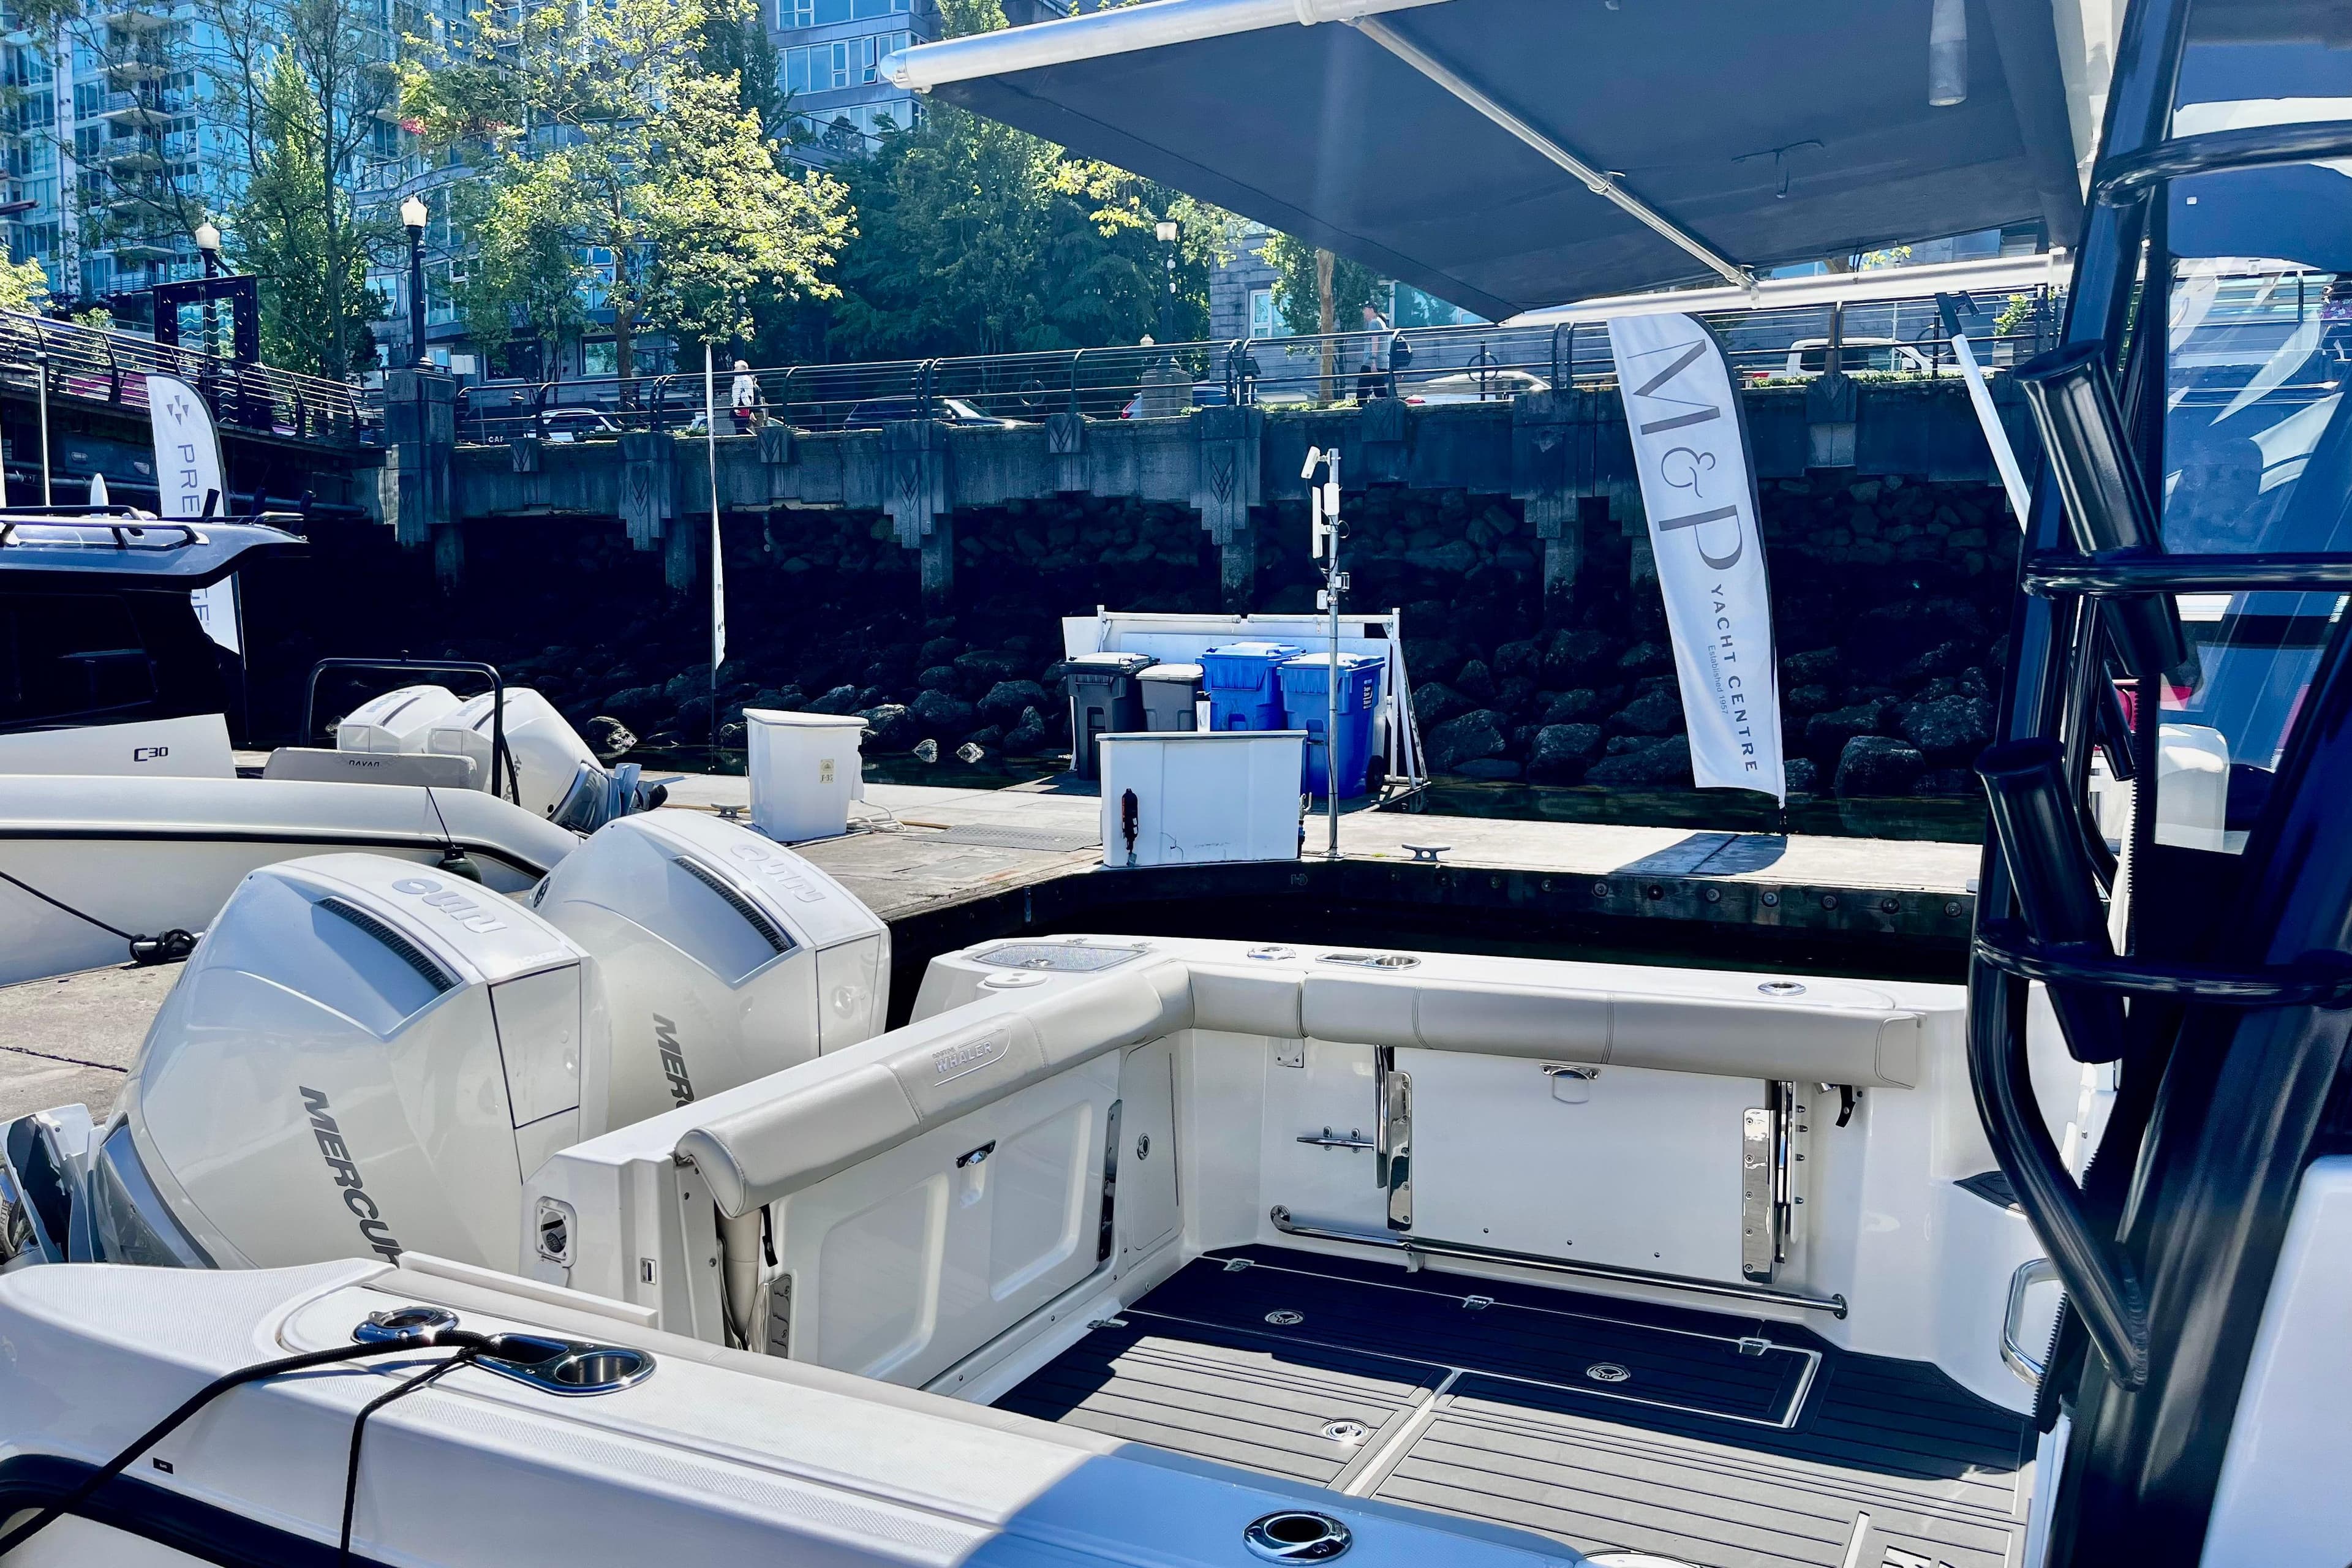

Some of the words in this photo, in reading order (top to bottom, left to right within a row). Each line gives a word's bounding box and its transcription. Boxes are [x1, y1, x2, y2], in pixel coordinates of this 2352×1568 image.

[1708, 644, 1724, 693] Established
[1718, 695, 1729, 715] 1957
[1711, 583, 1737, 663] YACHT
[1727, 675, 1758, 772] CENTRE
[134, 747, 168, 762] C30
[652, 1012, 695, 1109] MER
[935, 1041, 993, 1074] WHALER
